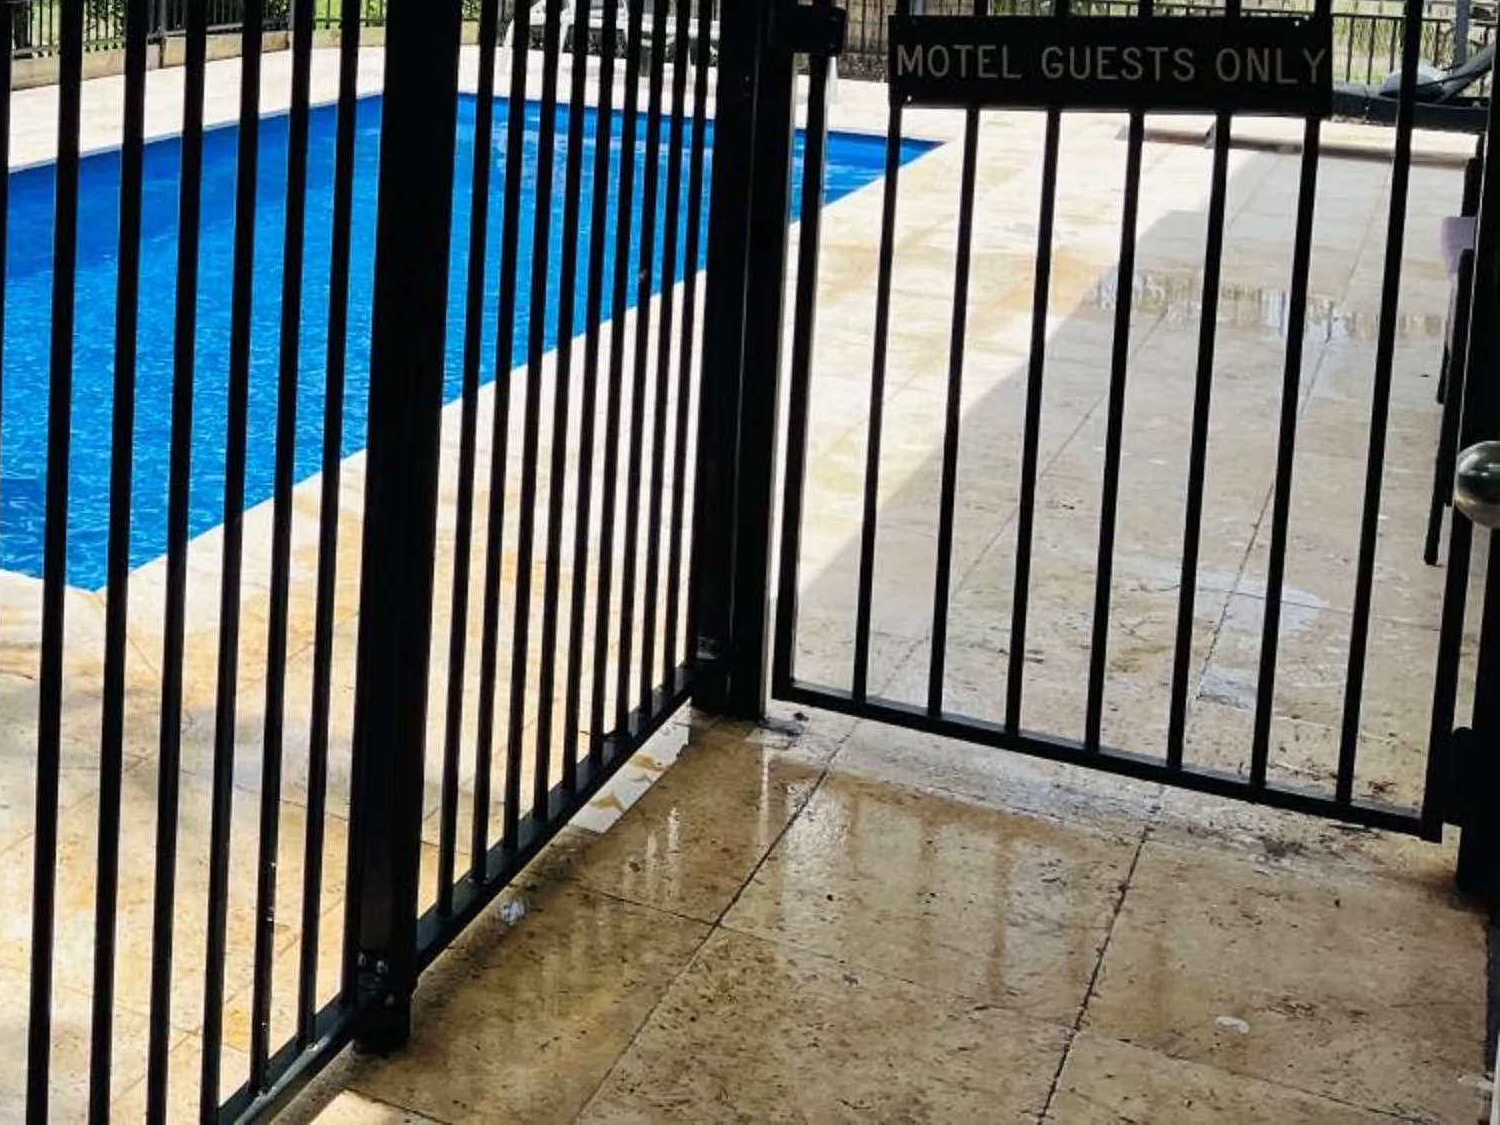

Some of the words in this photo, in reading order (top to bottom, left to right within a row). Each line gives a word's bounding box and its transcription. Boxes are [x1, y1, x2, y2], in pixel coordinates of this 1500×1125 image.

[897, 44, 1023, 79] MOTEL
[1041, 46, 1197, 82] GUESTS
[1215, 48, 1326, 85] ONLY
